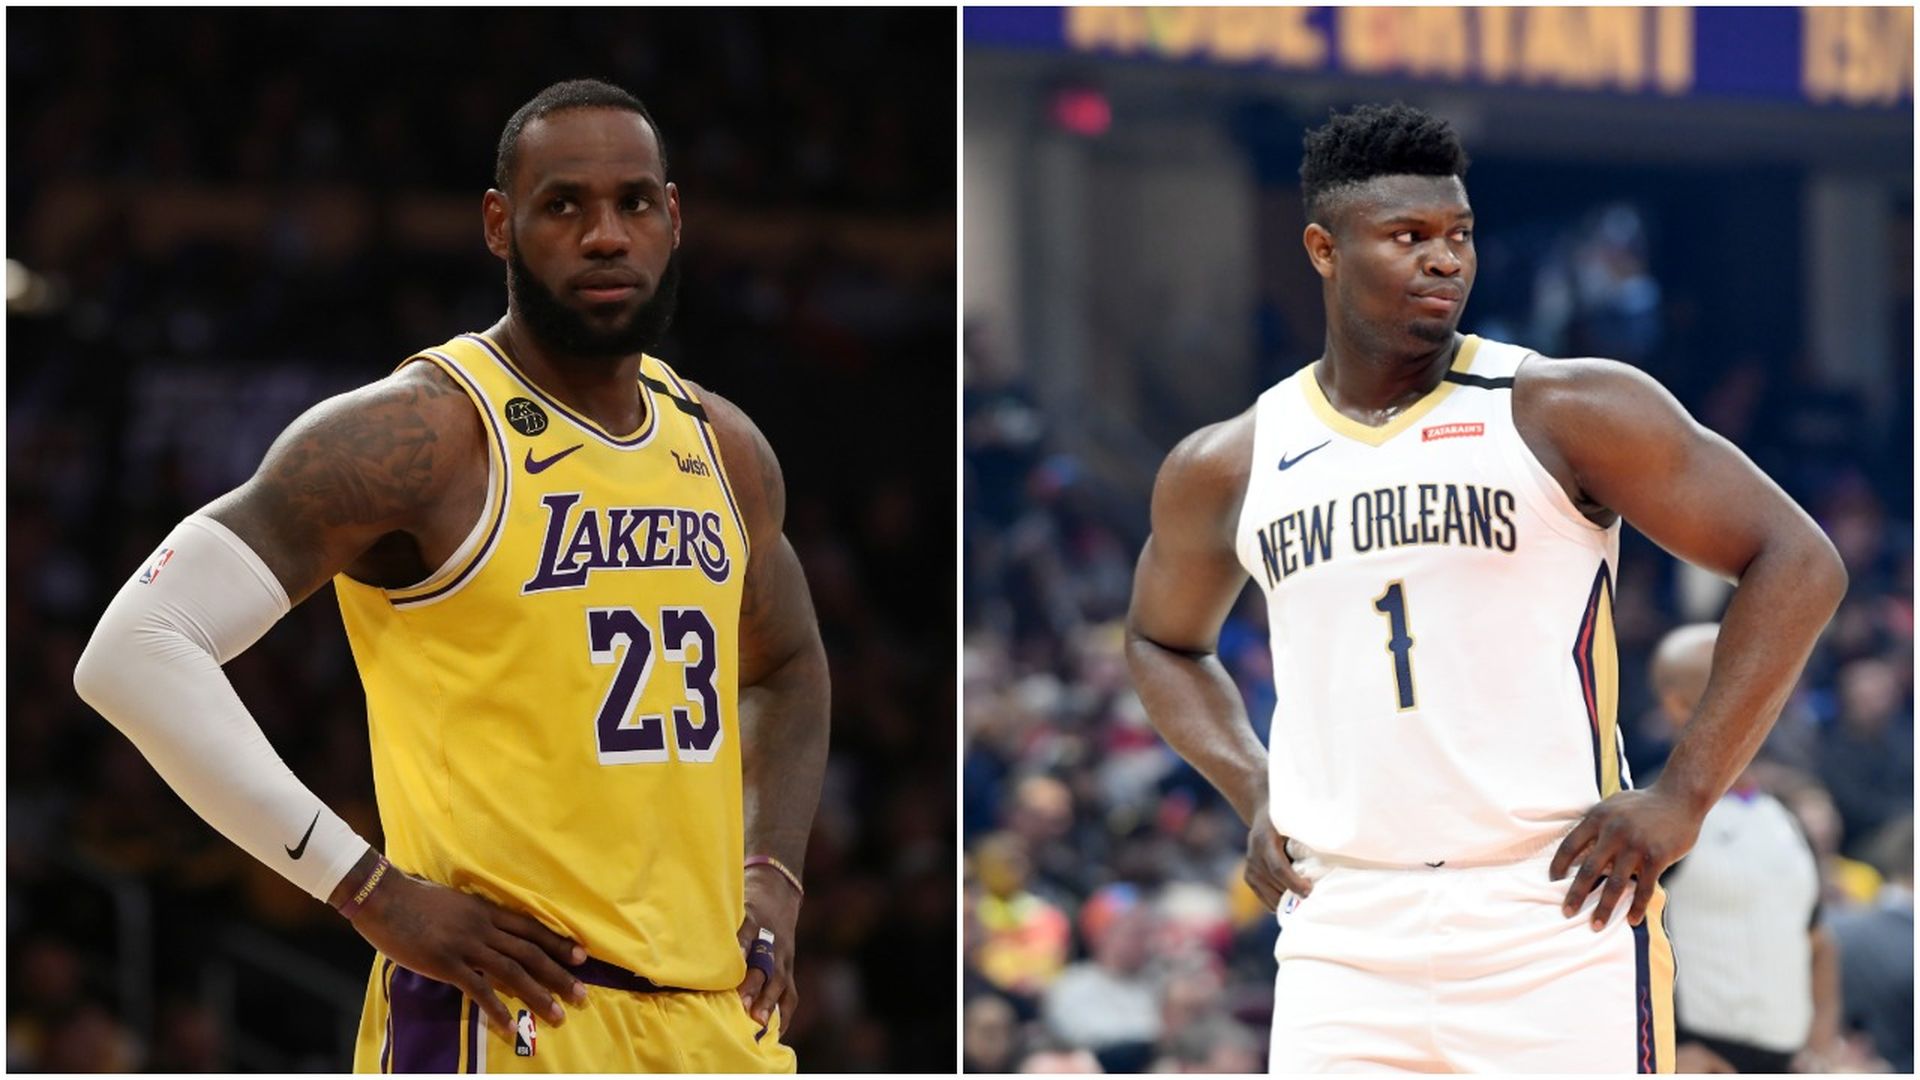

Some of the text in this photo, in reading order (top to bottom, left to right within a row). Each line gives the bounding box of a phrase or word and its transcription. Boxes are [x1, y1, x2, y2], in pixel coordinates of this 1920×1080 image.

[521, 491, 729, 595] LAKERS
[1257, 483, 1516, 590] NEW ORLEANS
[586, 607, 723, 764] 23
[1372, 578, 1418, 712] 1
